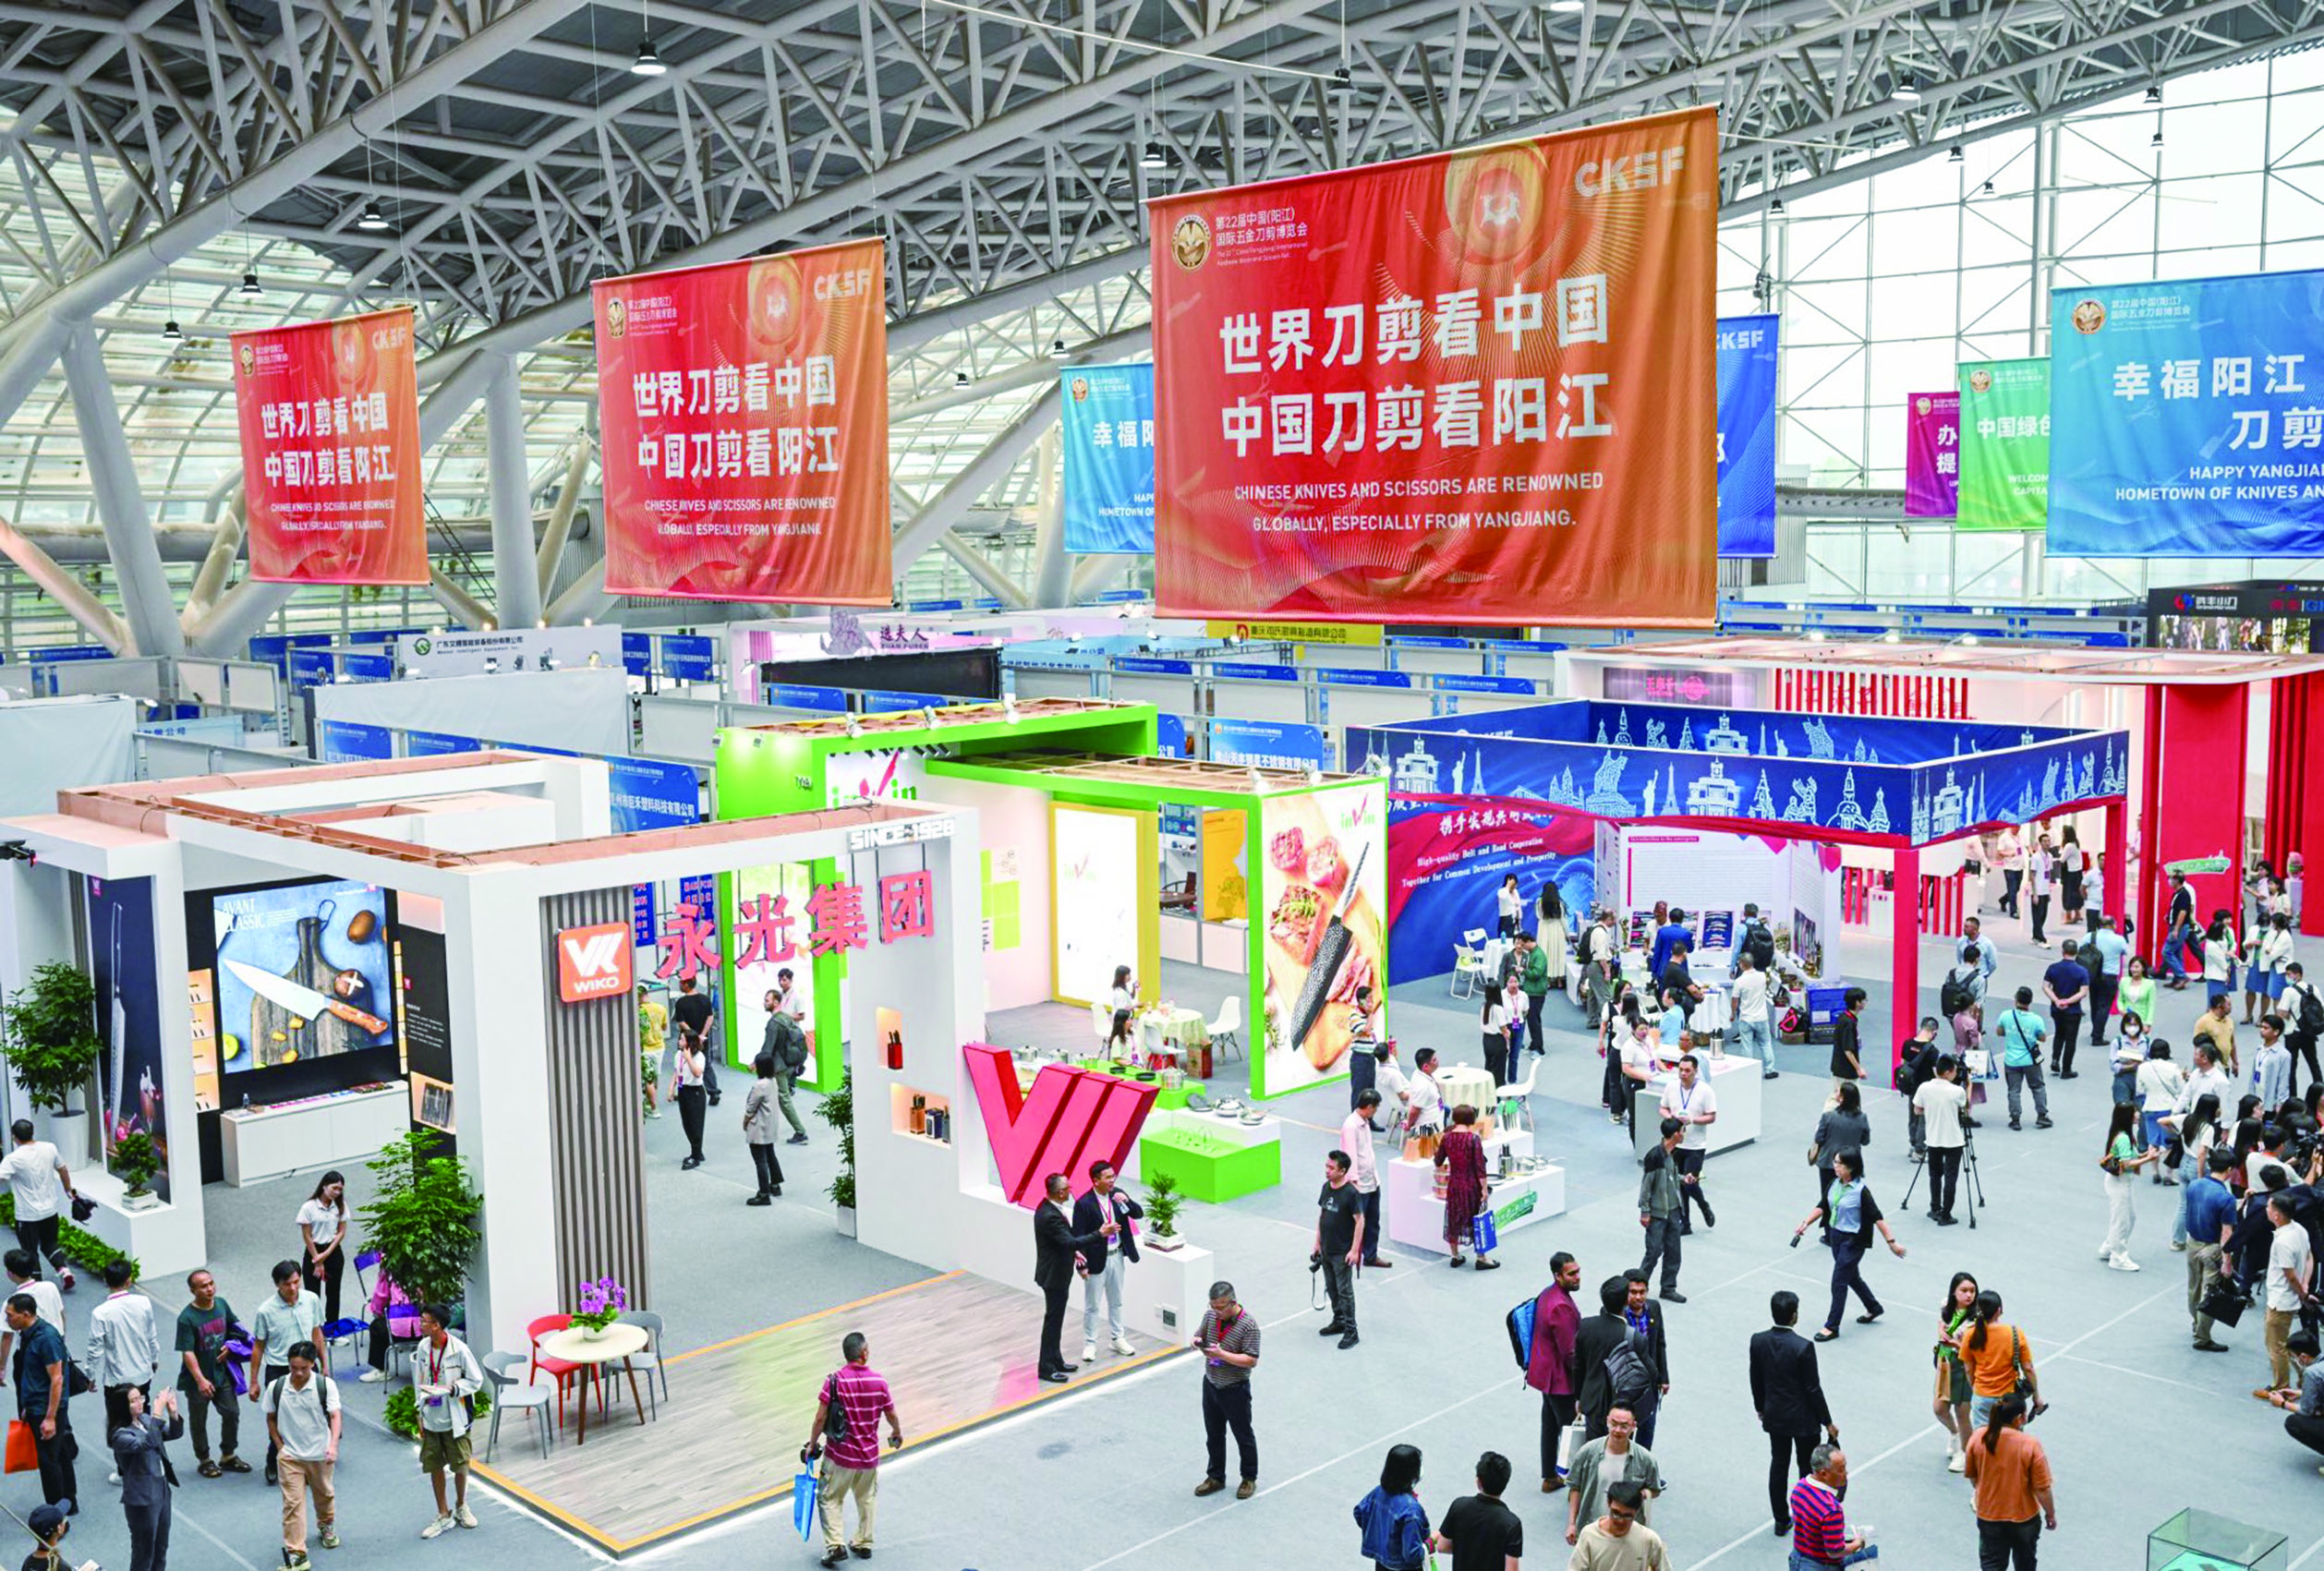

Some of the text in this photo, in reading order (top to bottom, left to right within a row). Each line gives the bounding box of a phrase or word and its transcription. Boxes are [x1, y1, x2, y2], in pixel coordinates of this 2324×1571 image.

[1575, 146, 1685, 198] CKSF
[814, 268, 872, 301] CKSF
[1218, 273, 1608, 375] 世界刀剪看中国
[633, 355, 836, 417] 世界刀剪看中国
[2112, 355, 2306, 401] 幸福阳江
[260, 392, 389, 439] 世界刀剪看中国
[1221, 372, 1613, 457] 中国刀剪看阳江
[2228, 406, 2324, 451] 刀剪
[1937, 424, 1957, 446] 办
[264, 445, 396, 488] 中国刀剪看阳江
[638, 426, 839, 480] 中国刀剪看阳江
[1937, 453, 1956, 474] 提
[1234, 472, 1604, 500] CHINESE KNIVES AND SCISSORS ARE RENOWNED
[2189, 465, 2245, 479] HAPPY
[723, 498, 762, 511] SCISSORS
[763, 498, 784, 510] ARE
[2115, 487, 2205, 501] HOMETOWN
[2209, 486, 2232, 500] OF
[2236, 485, 2298, 499] KNIVES
[744, 523, 769, 536] FROM
[1253, 509, 1577, 533] GLOBALLY, ESPECIALLY FROM YANGJIANG.
[850, 826, 907, 850] SINCE
[1417, 852, 1459, 867] High-quality
[1462, 849, 1476, 858] Belt
[1478, 846, 1489, 855] and
[1509, 837, 1543, 850] Cooperation
[1401, 852, 1556, 888] Together for Common Development and Prosperity
[655, 870, 934, 981] 永光集团
[574, 975, 620, 994] WIKO
